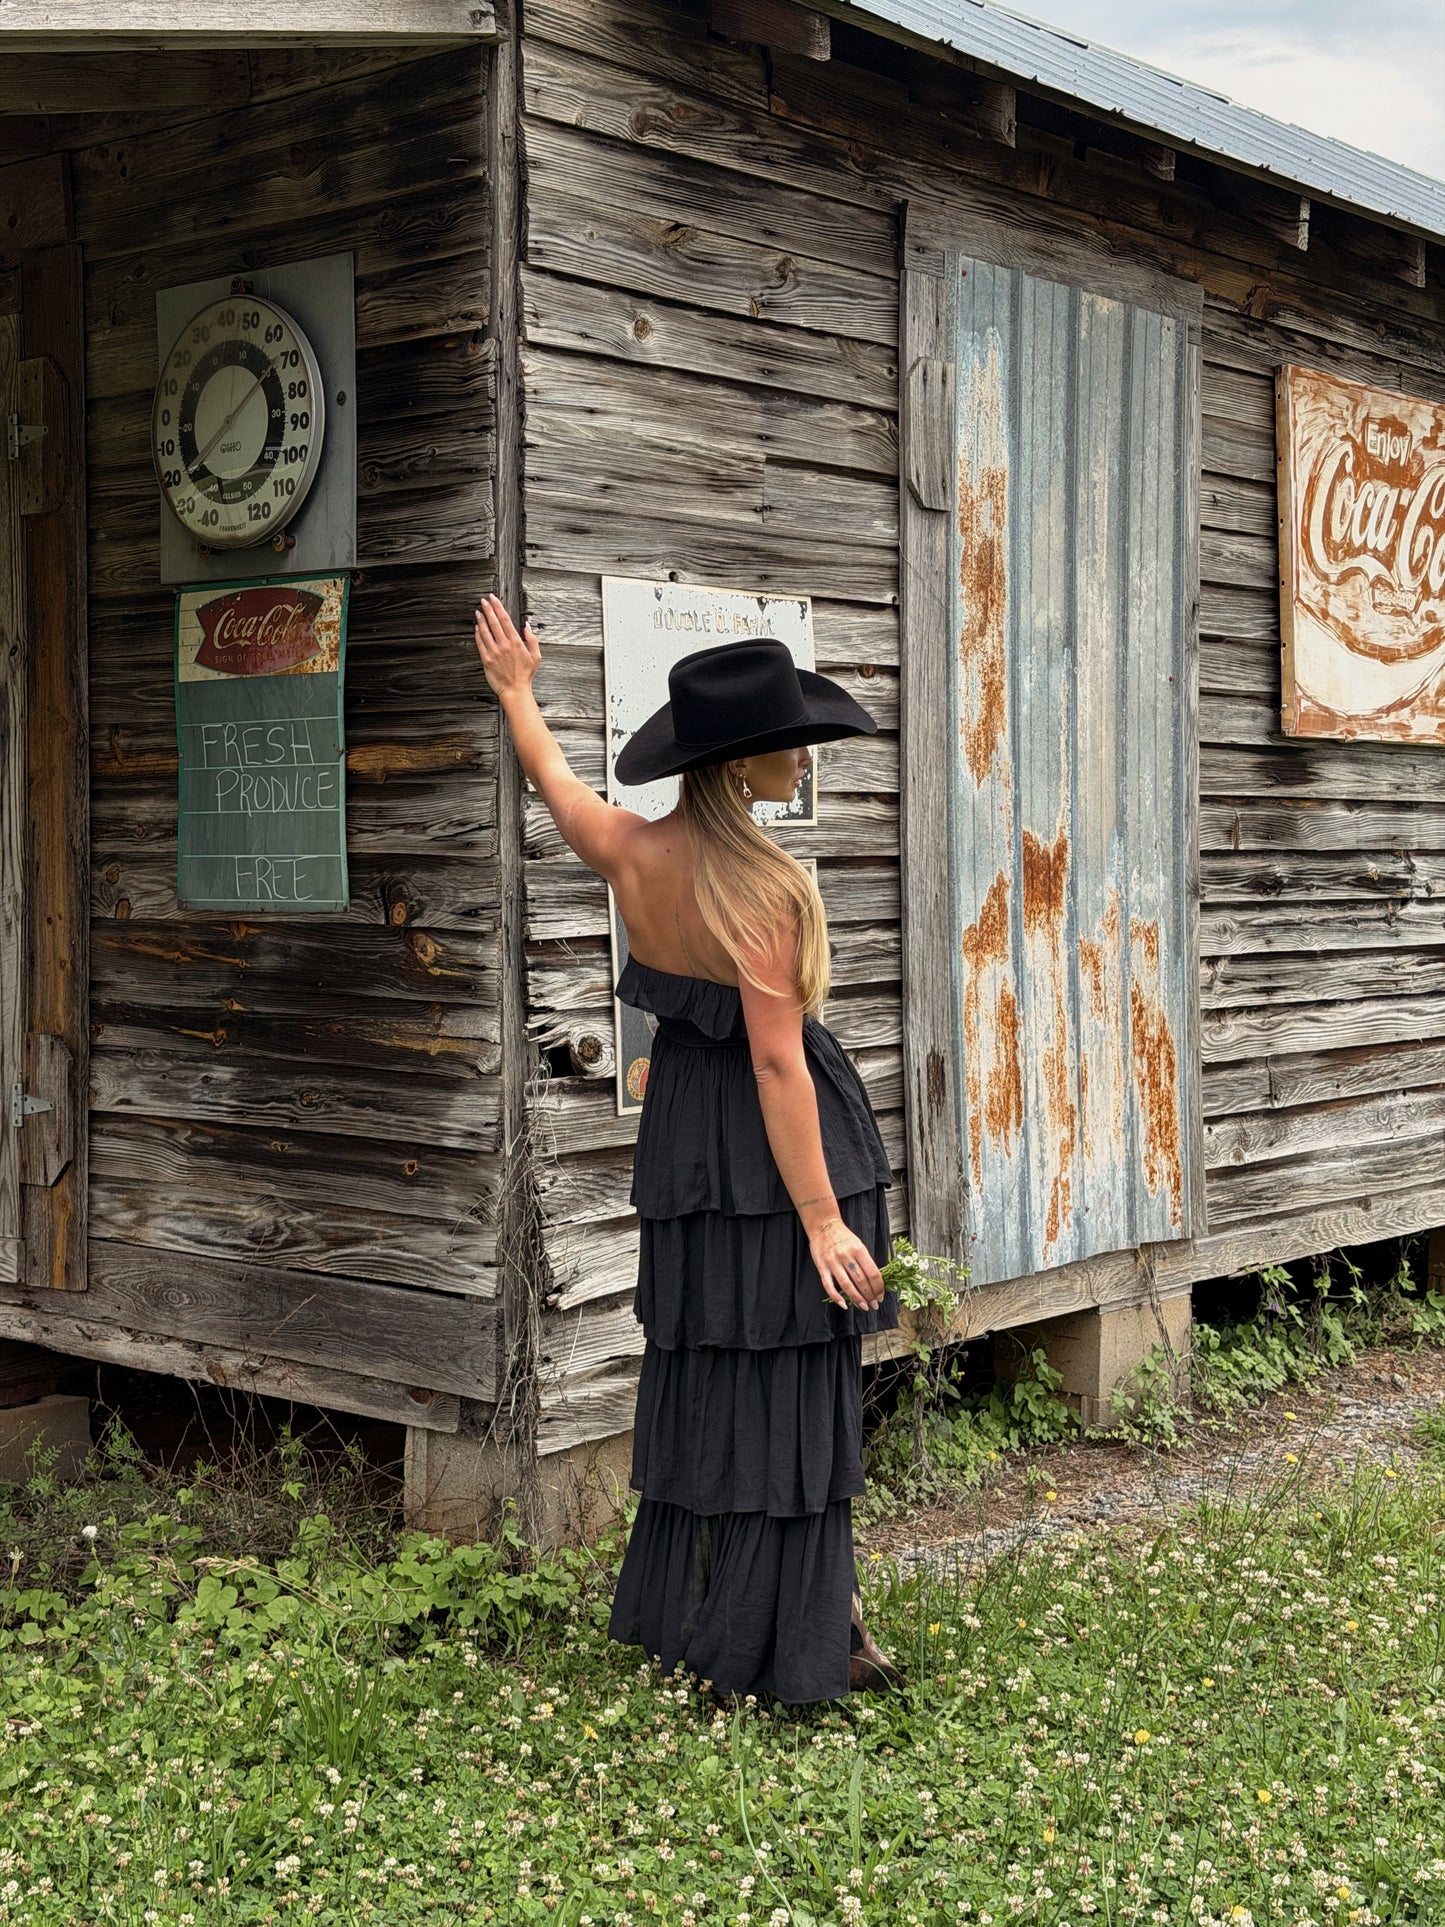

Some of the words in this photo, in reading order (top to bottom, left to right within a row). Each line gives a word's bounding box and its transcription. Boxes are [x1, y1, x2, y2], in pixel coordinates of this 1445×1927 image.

[241, 311, 260, 330] 50
[191, 327, 210, 344] 30
[264, 323, 283, 344] 60
[173, 350, 191, 368] 20
[240, 351, 248, 360] 10
[280, 349, 299, 370] 70
[162, 379, 178, 396] 10
[288, 380, 307, 400] 80
[161, 408, 170, 426] 0
[271, 408, 281, 419] 30
[290, 411, 309, 432] 90
[1366, 421, 1411, 468] Enjoy
[281, 445, 308, 464] 100
[222, 491, 242, 500] CELSIUS
[242, 481, 252, 491] 50
[273, 478, 295, 498] 110
[197, 508, 219, 528] -40
[247, 501, 271, 521] 120
[219, 522, 247, 531] FAHRENHEIT
[653, 607, 711, 633] DOUBLE
[214, 654, 233, 664] SIGN
[202, 720, 316, 773] FRESH
[215, 769, 337, 817] PRODUCE
[235, 855, 320, 901] FREE
